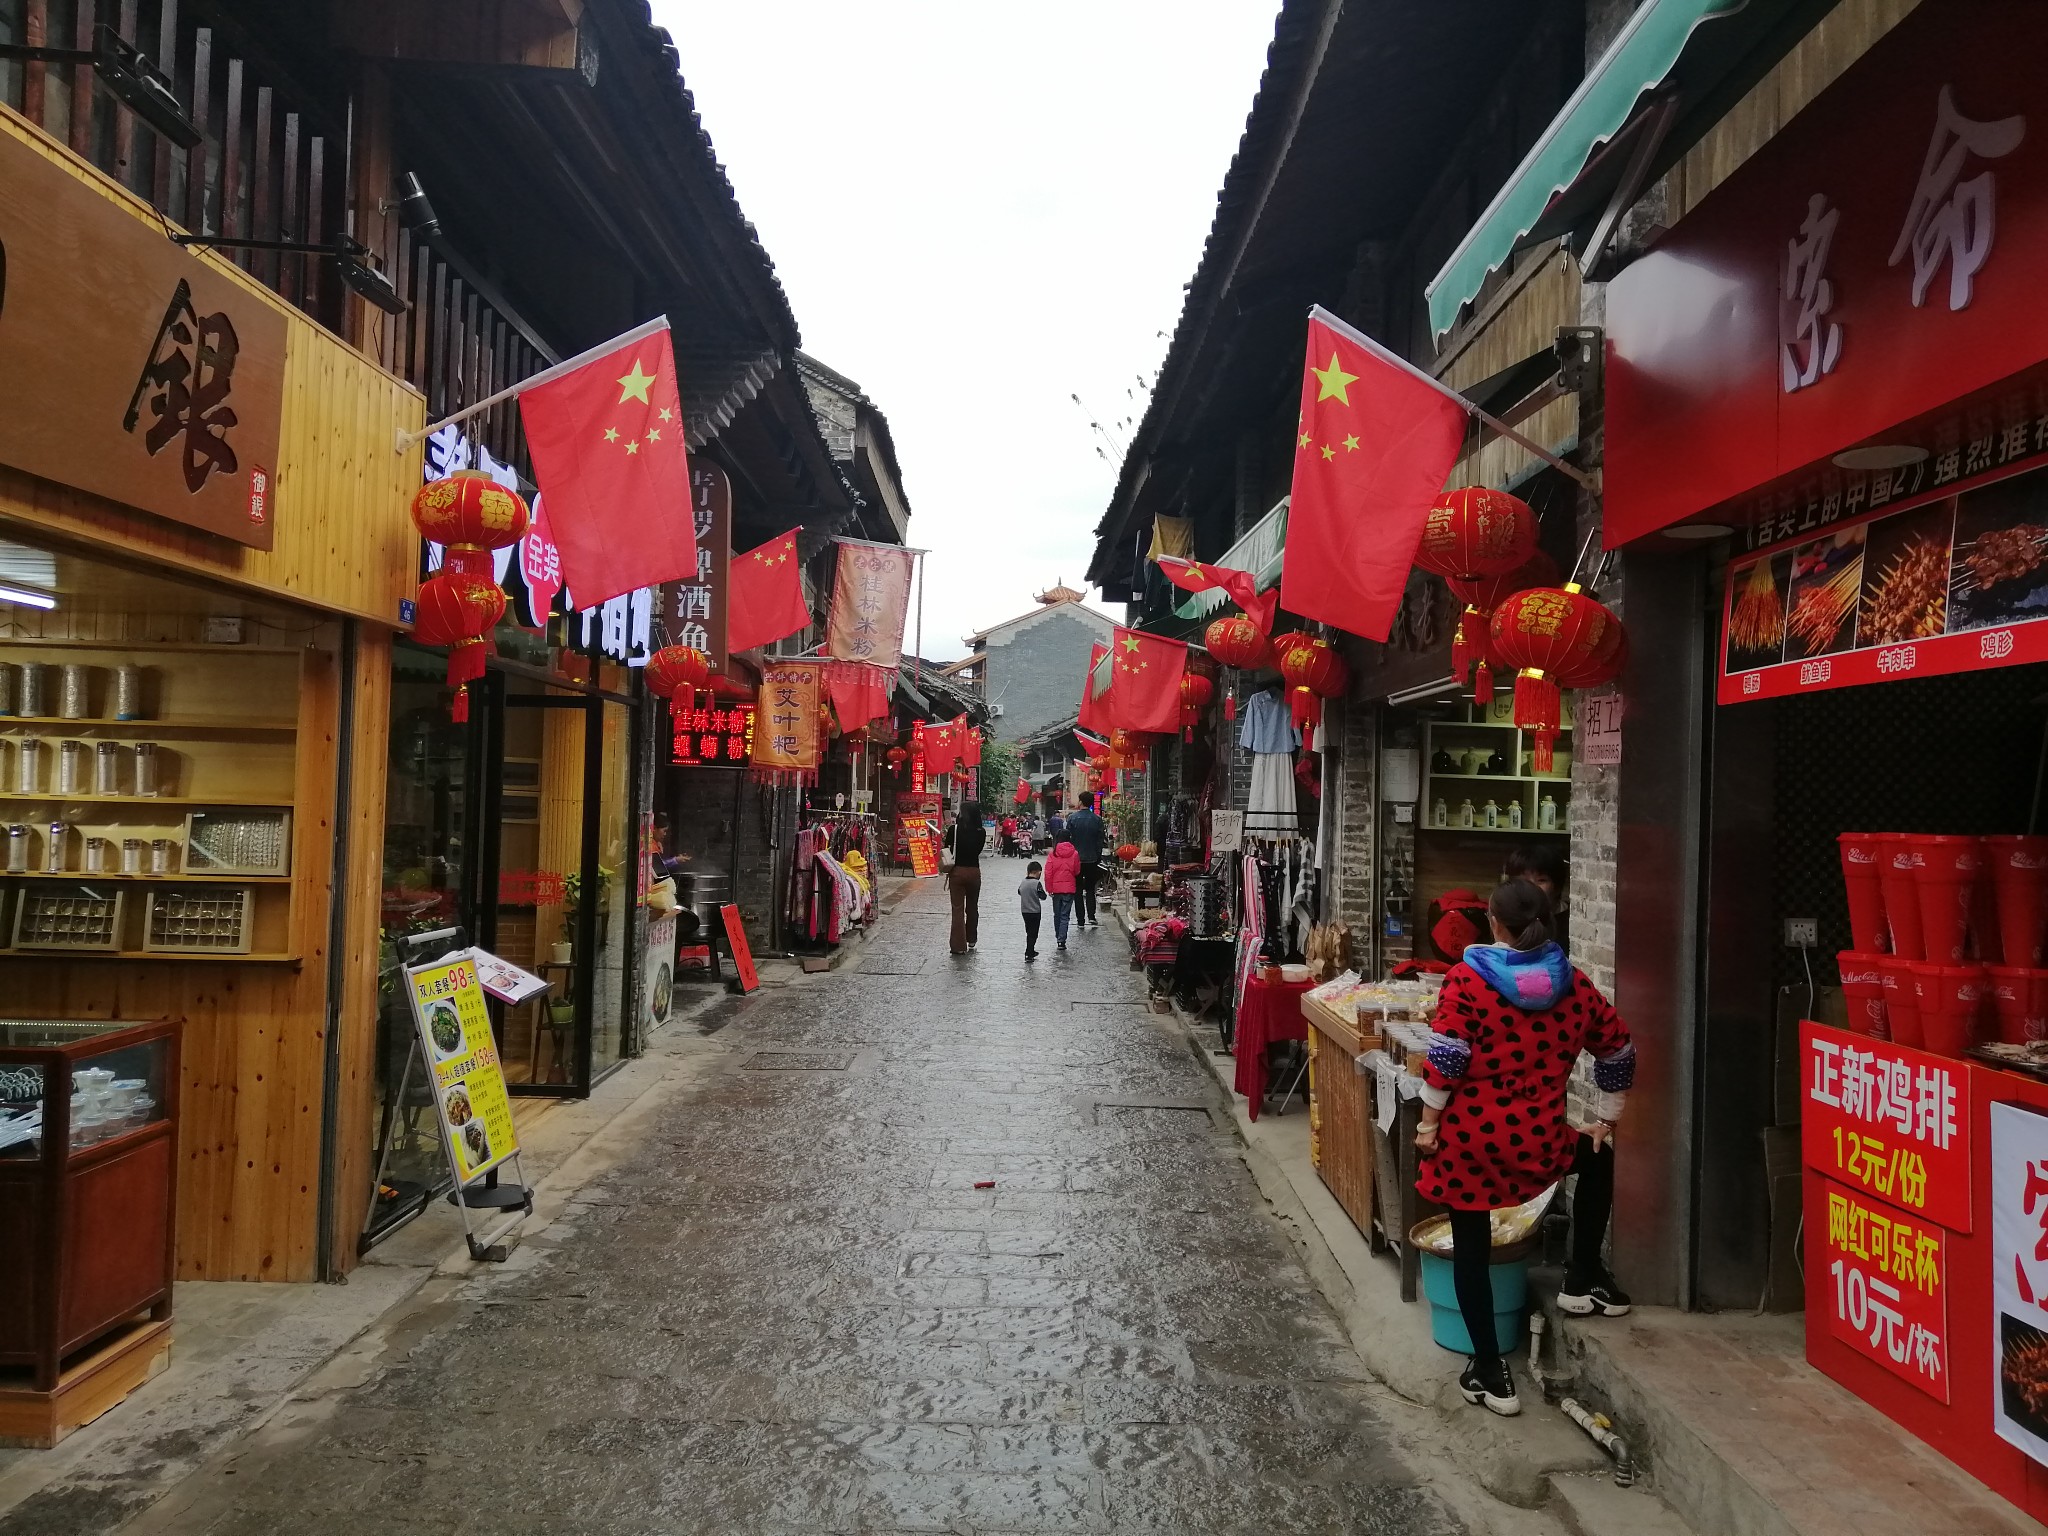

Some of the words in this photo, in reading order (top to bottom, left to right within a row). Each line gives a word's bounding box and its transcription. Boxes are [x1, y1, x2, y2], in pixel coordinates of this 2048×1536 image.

[851, 574, 885, 657] 桂林米粉
[1800, 661, 1831, 685] 鱿鱼串
[1877, 646, 1916, 673] 牛肉串
[773, 688, 801, 756] 艾叶粑
[1587, 699, 1621, 737] 招工
[1213, 812, 1242, 827] 特价
[1810, 1037, 1957, 1150] 正新鸡排
[1832, 1126, 1927, 1208] 12元/份
[1829, 1192, 1939, 1297] 网红可乐杯
[1831, 1259, 1941, 1381] 10元/杯
